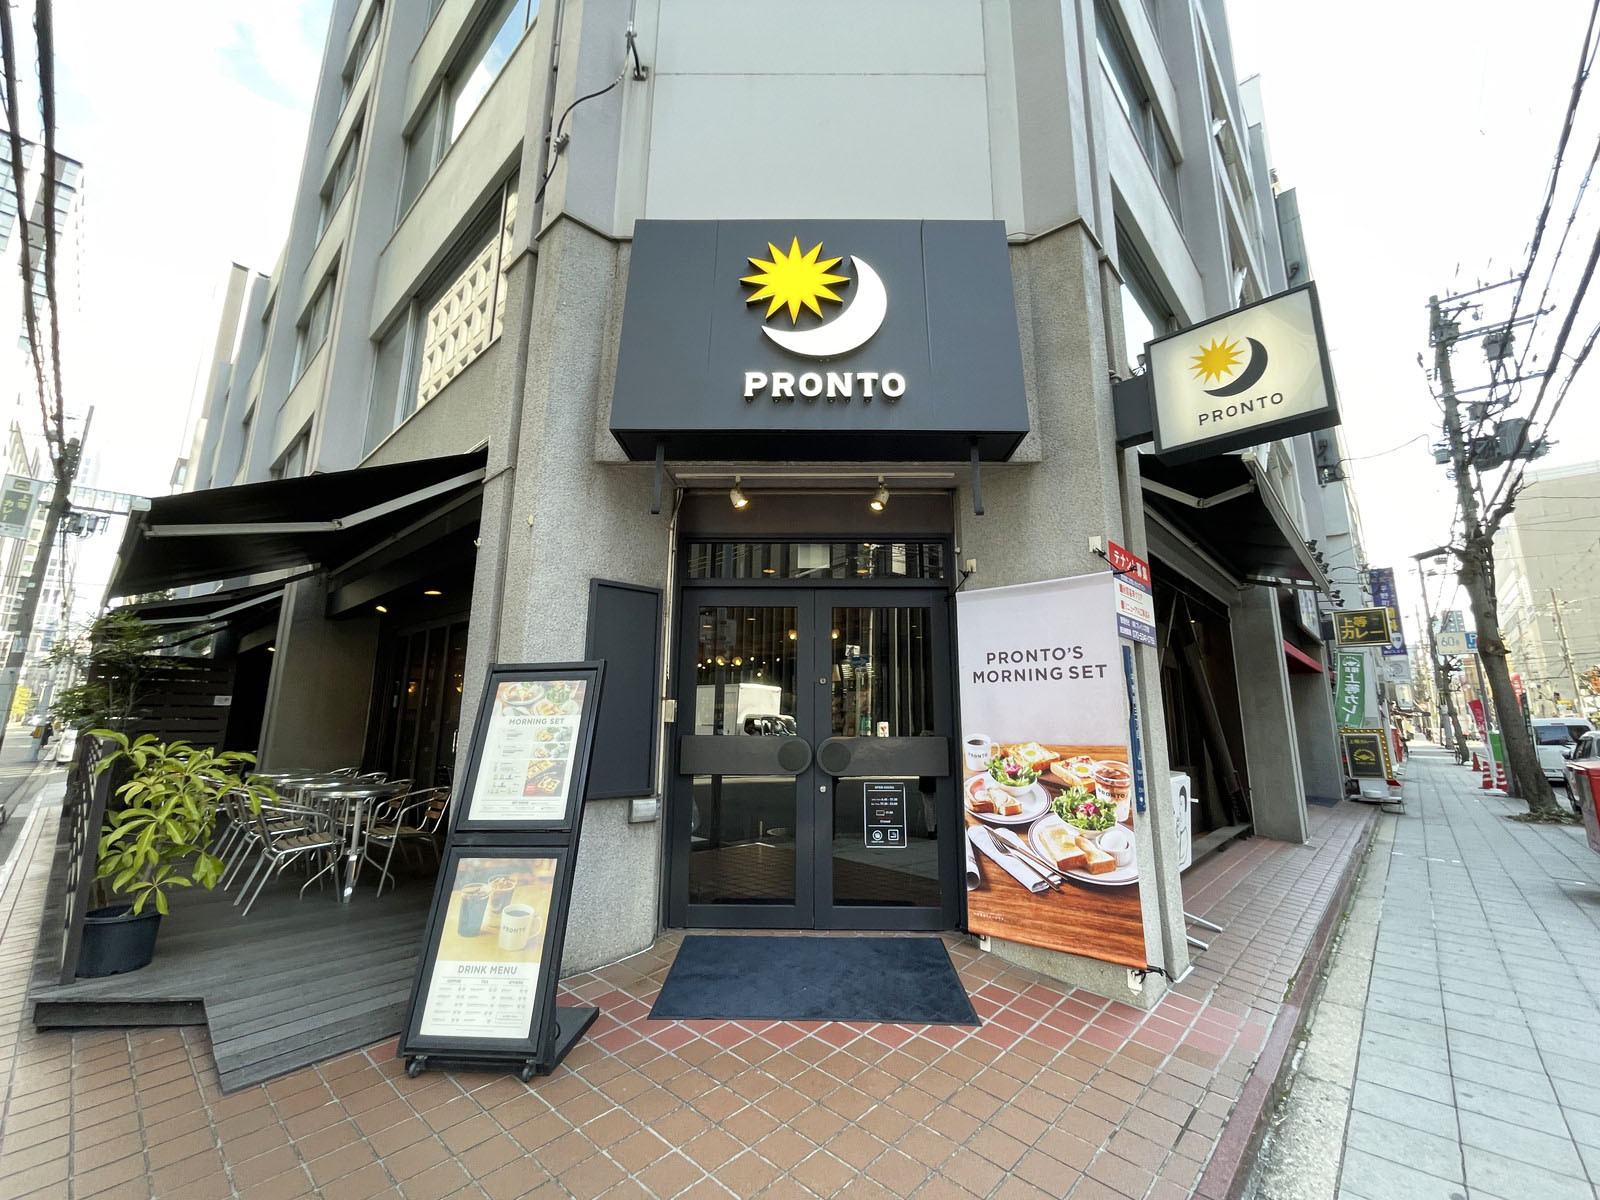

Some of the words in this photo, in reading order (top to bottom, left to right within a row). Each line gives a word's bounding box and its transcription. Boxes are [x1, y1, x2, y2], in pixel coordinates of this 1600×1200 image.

[744, 371, 906, 399] PRONTO
[1198, 392, 1284, 426] PRONTO
[1340, 615, 1368, 628] 上等
[1341, 627, 1385, 639] カレー
[986, 645, 1084, 665] PRONTO'S
[973, 667, 1063, 684] MORNING
[1068, 664, 1107, 679] SET
[508, 718, 547, 726] MORNING
[550, 717, 565, 725] SET
[1097, 787, 1125, 798] PRONTO
[457, 965, 487, 974] DRINK
[490, 966, 518, 975] MENU
